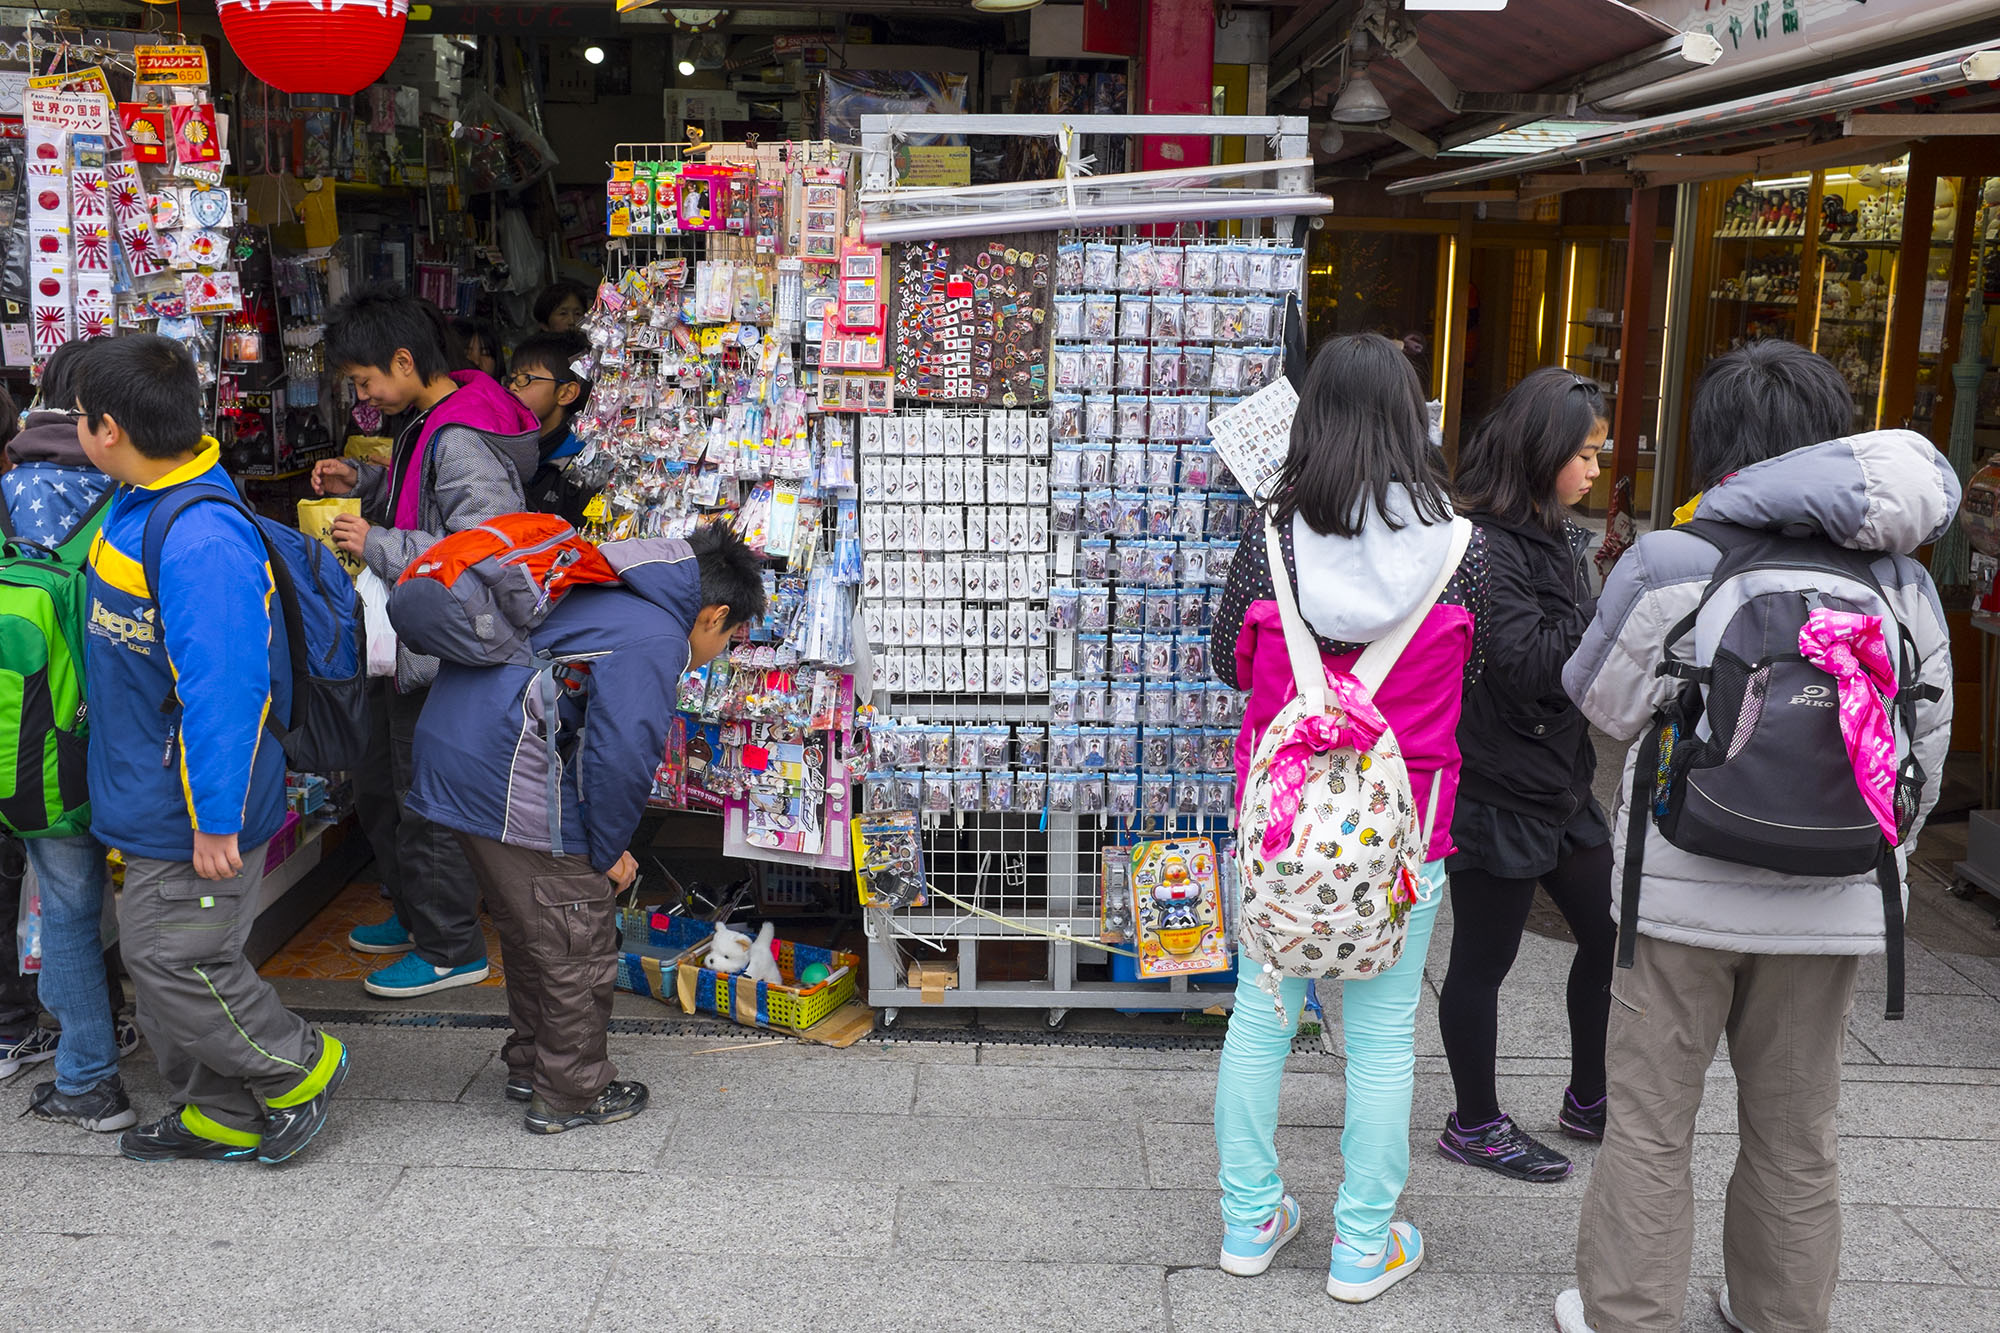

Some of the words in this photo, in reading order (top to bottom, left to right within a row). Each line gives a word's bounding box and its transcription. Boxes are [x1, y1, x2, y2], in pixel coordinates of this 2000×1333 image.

[179, 70, 202, 81] 650
[32, 100, 101, 117] 世界の国旗
[180, 165, 218, 182] TOKYO
[91, 597, 155, 642] Kaepa
[687, 787, 704, 798] TOKYO
[704, 793, 724, 805] TOWER
